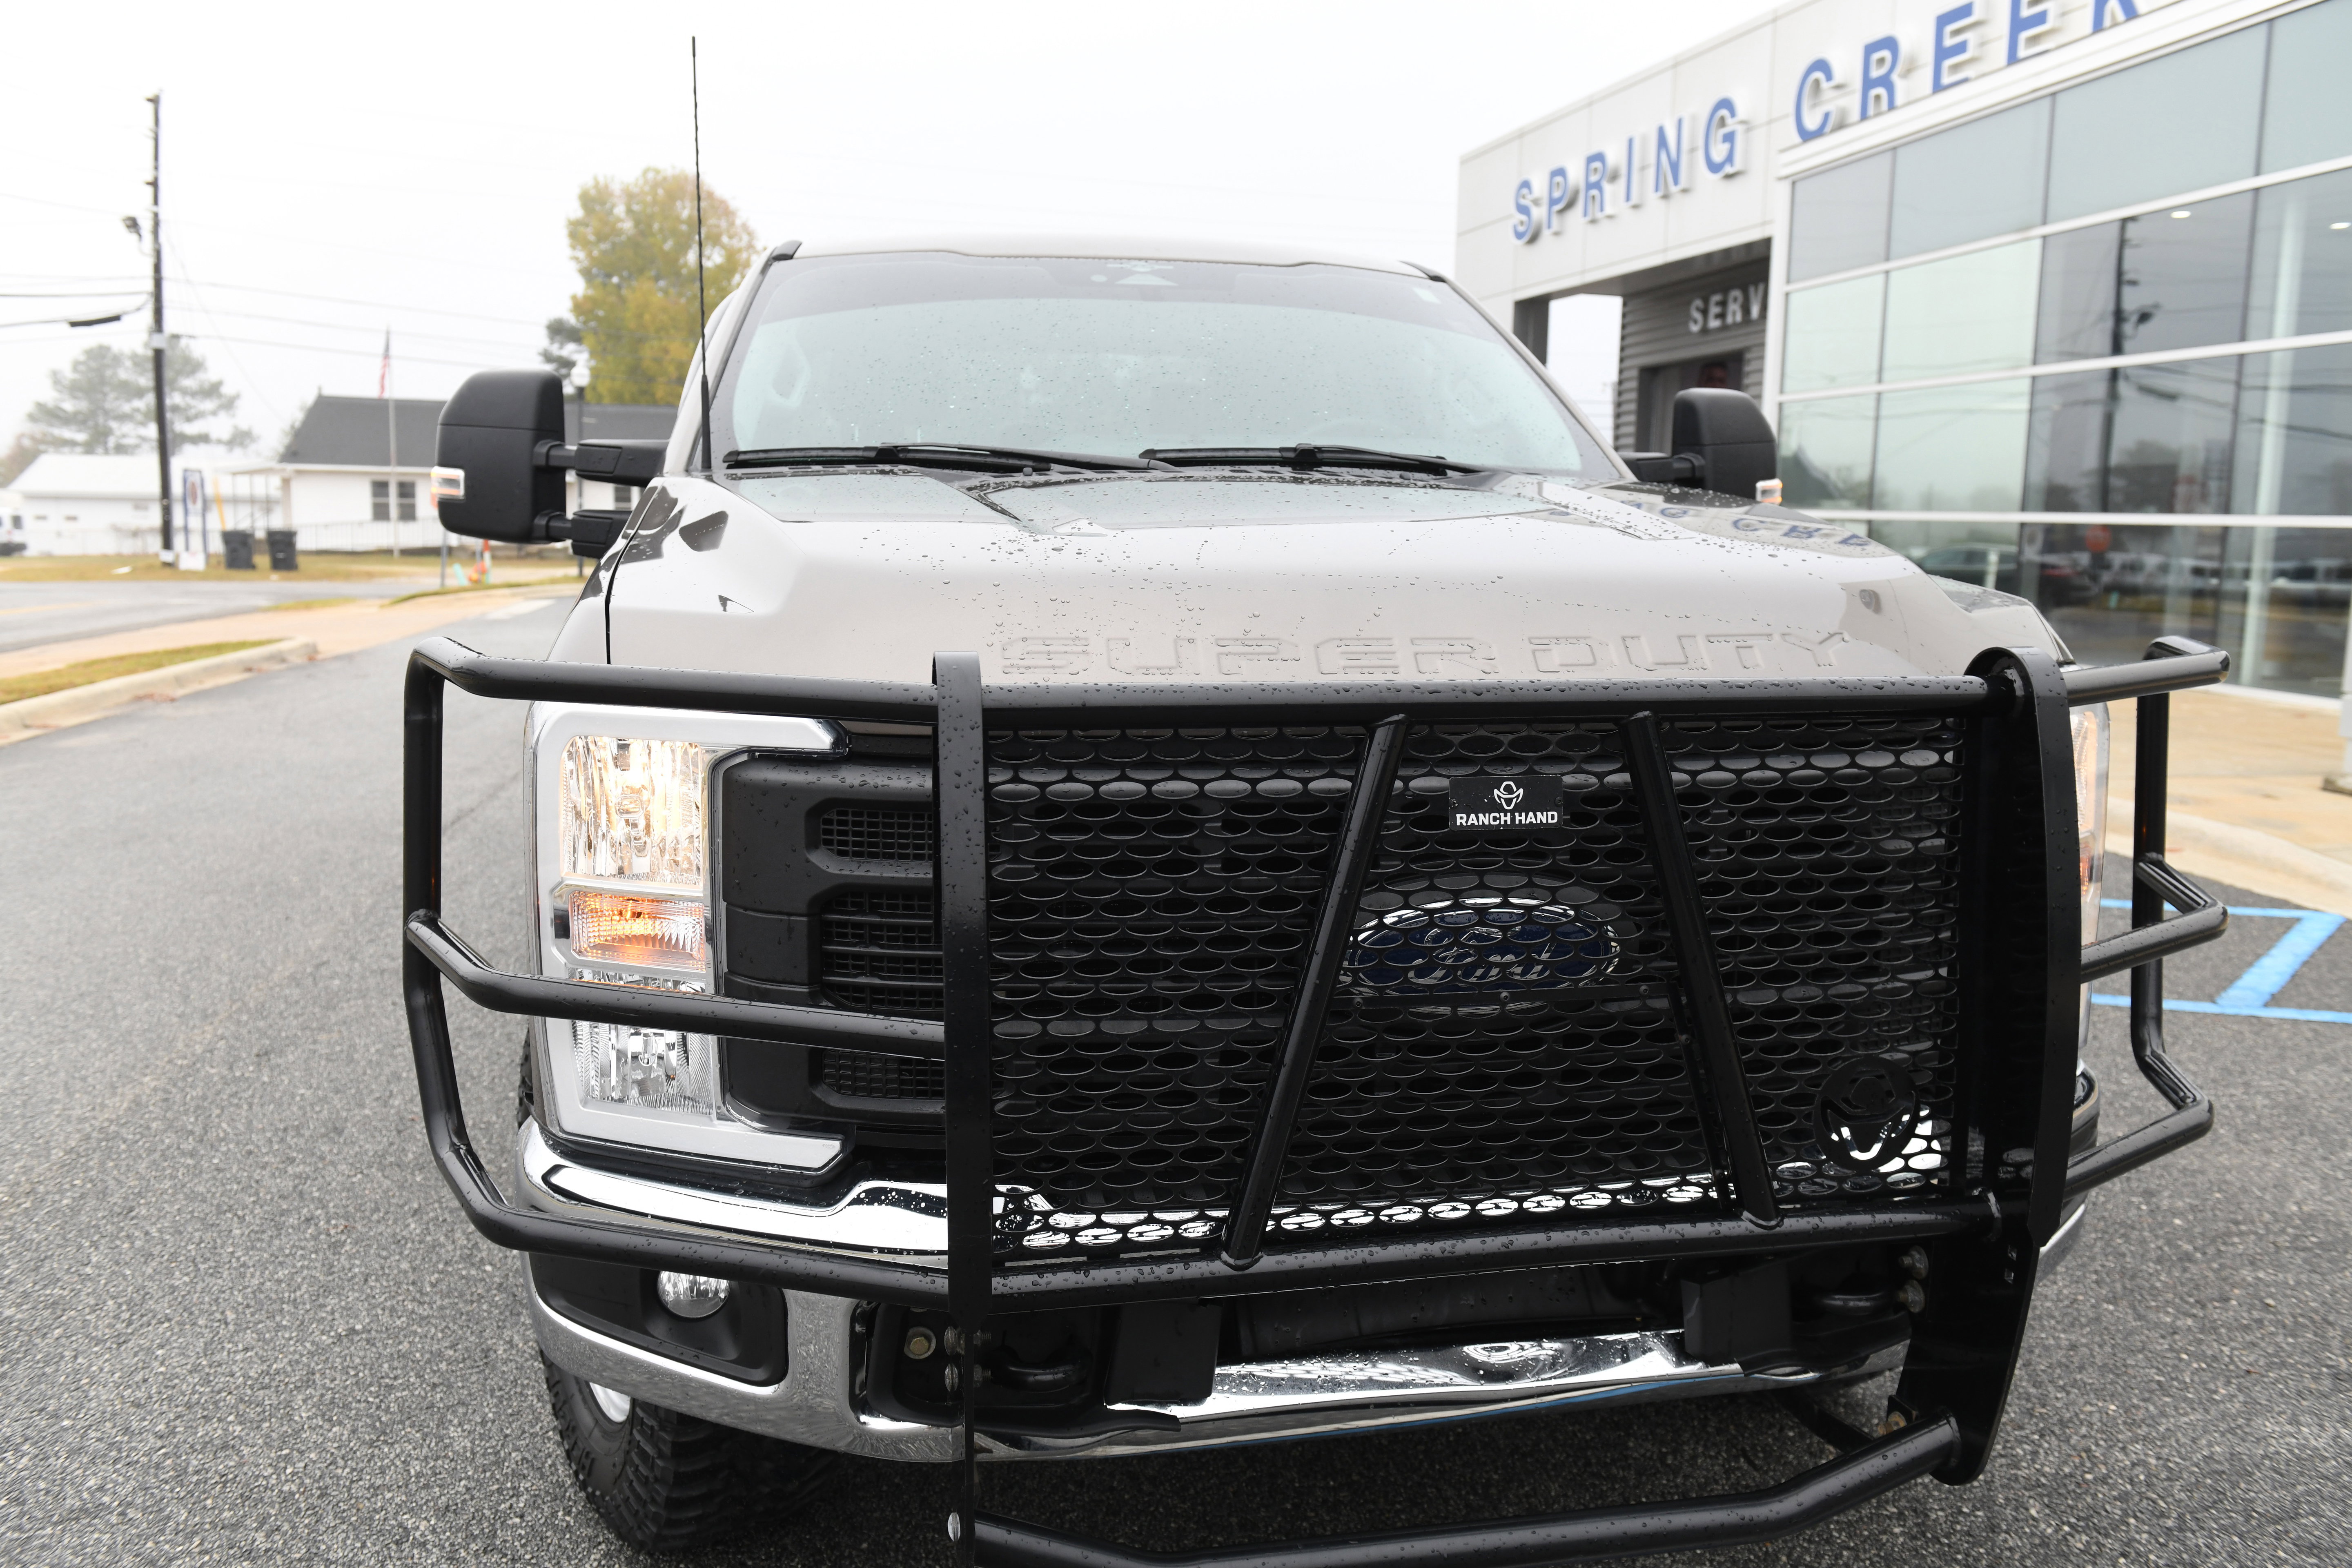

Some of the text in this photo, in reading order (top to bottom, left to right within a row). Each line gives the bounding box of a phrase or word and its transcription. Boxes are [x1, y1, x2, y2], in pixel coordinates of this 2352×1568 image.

[1512, 95, 1739, 241] SPRING
[1688, 282, 1766, 333] SERV
[1000, 631, 1850, 675] SUPER DUTY
[1456, 811, 1558, 826] RANCH HAND
